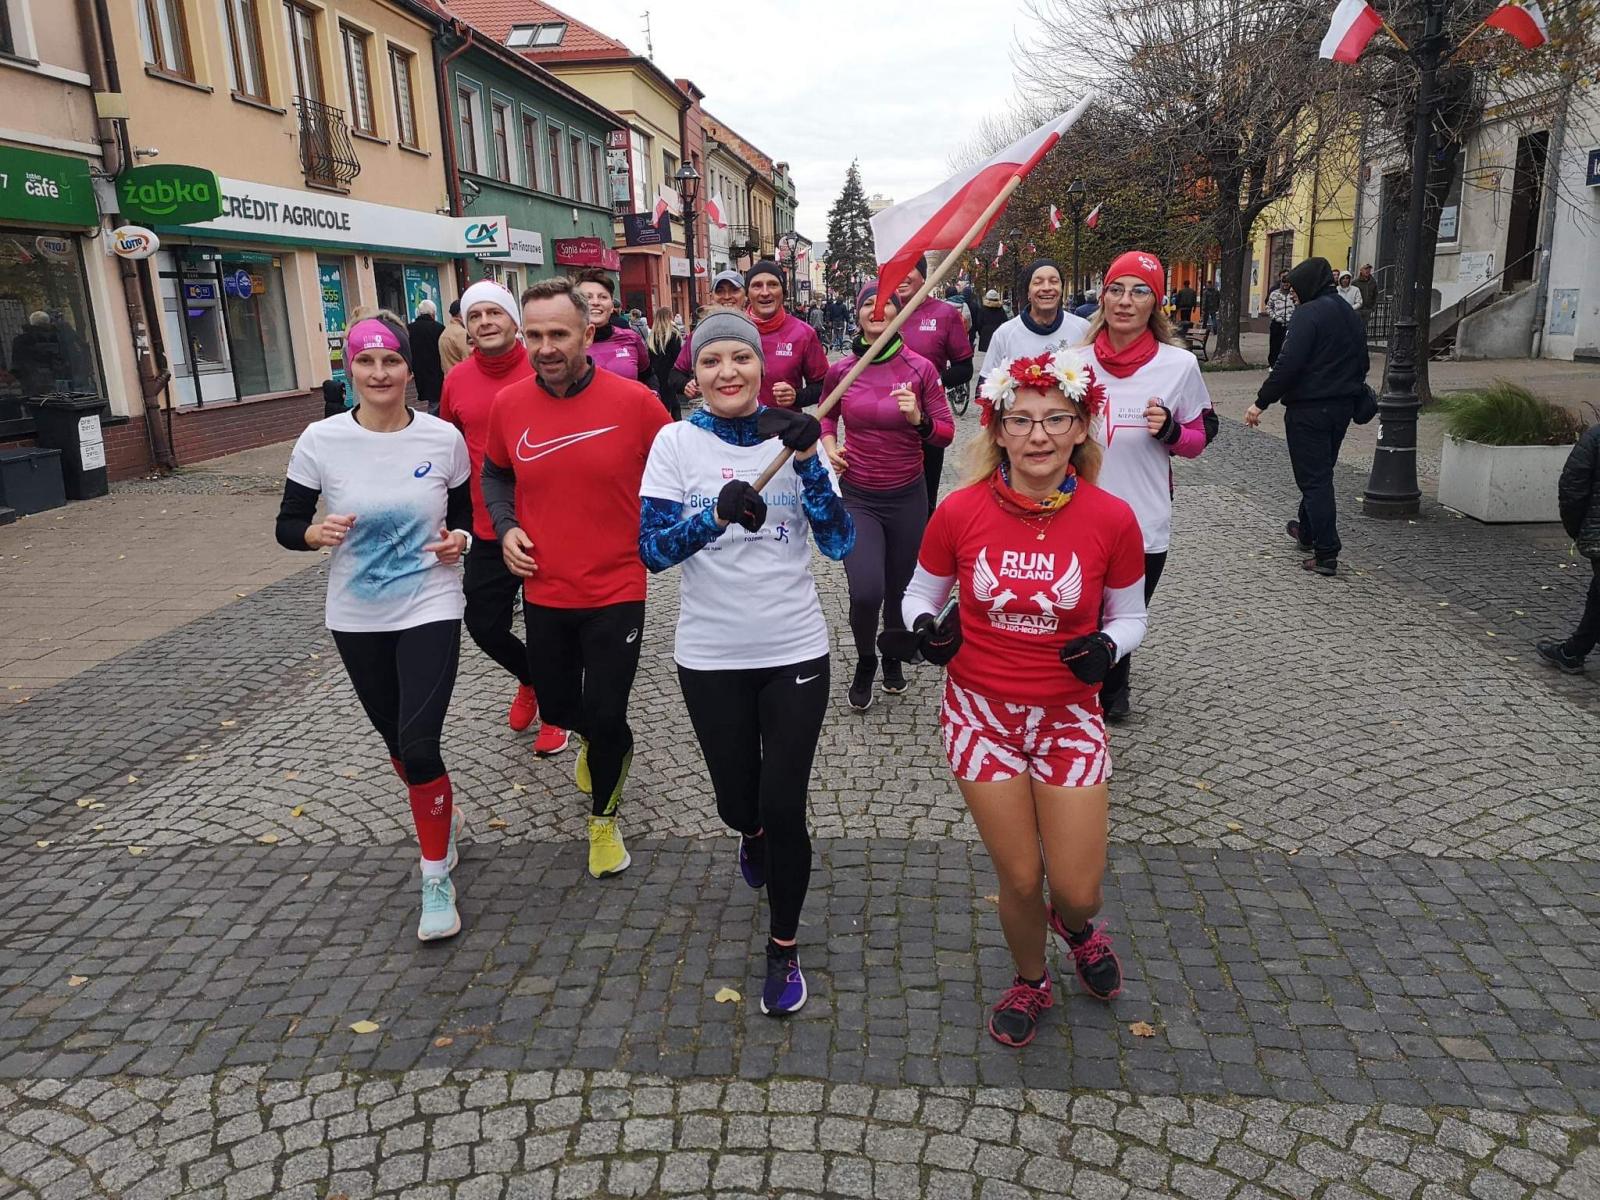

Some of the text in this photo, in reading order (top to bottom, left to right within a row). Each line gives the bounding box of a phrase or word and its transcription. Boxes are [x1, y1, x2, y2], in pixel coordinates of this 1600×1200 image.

[123, 180, 210, 204] żabka
[221, 194, 351, 231] CRÉDIT AGRICOLE
[120, 238, 143, 250] LOTTO
[363, 256, 369, 270] 8
[1002, 550, 1055, 570] RUN
[999, 566, 1054, 581] POLAND
[990, 613, 1057, 629] TEAM
